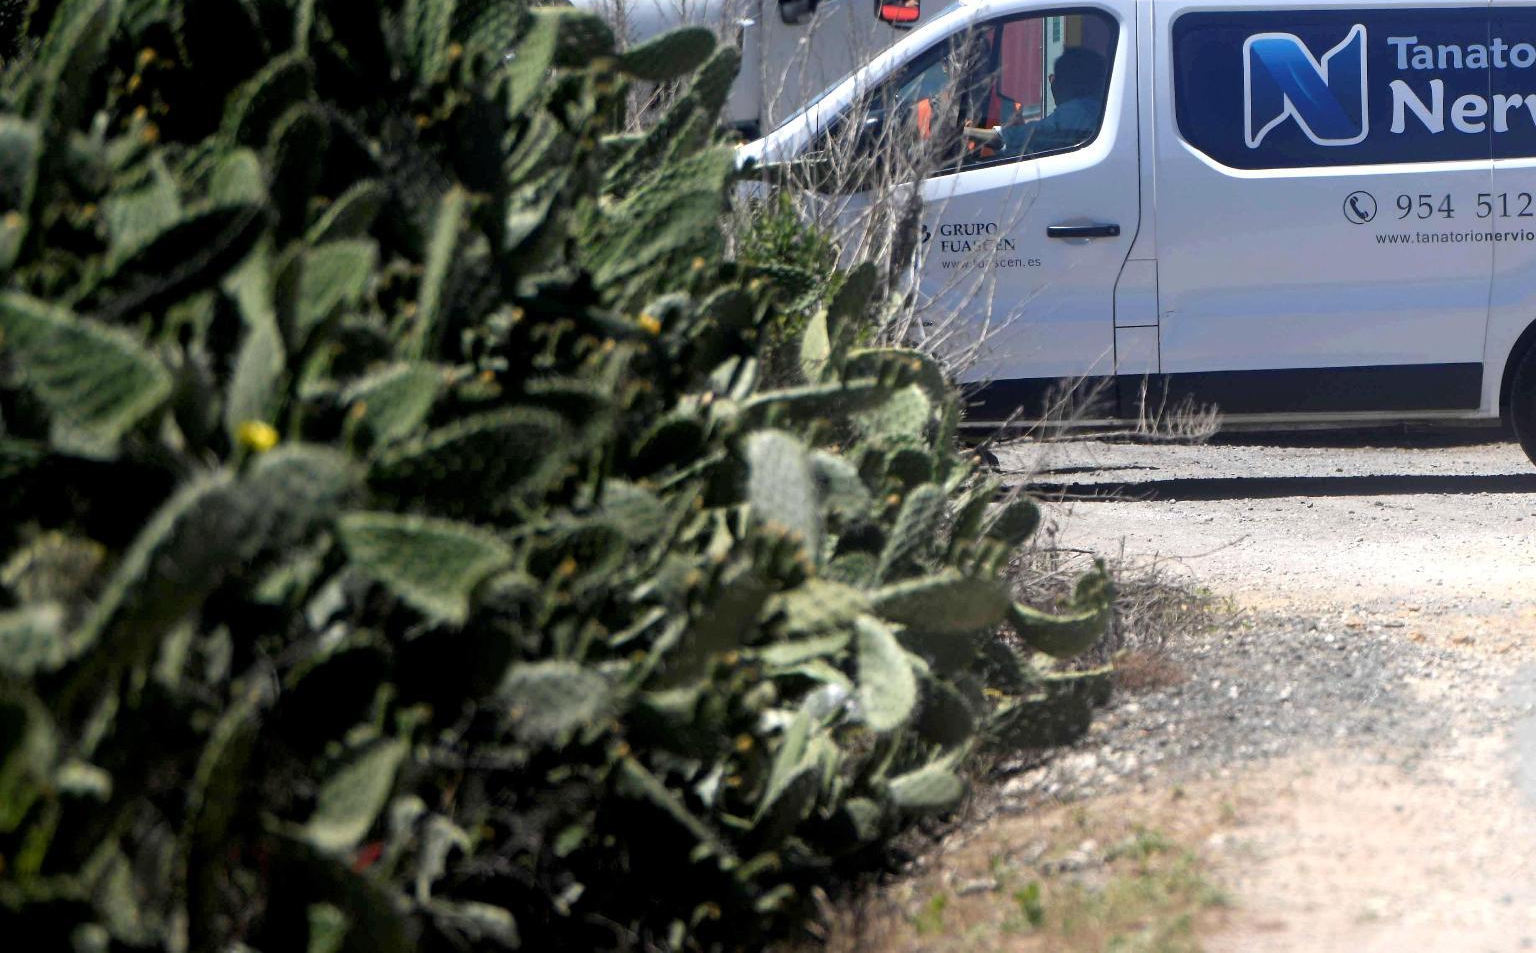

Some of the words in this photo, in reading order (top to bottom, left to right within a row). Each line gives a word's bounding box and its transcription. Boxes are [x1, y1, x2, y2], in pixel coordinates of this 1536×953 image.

[1396, 194, 1455, 220] 954
[1476, 192, 1535, 218] 512
[940, 222, 998, 236] GRUPO
